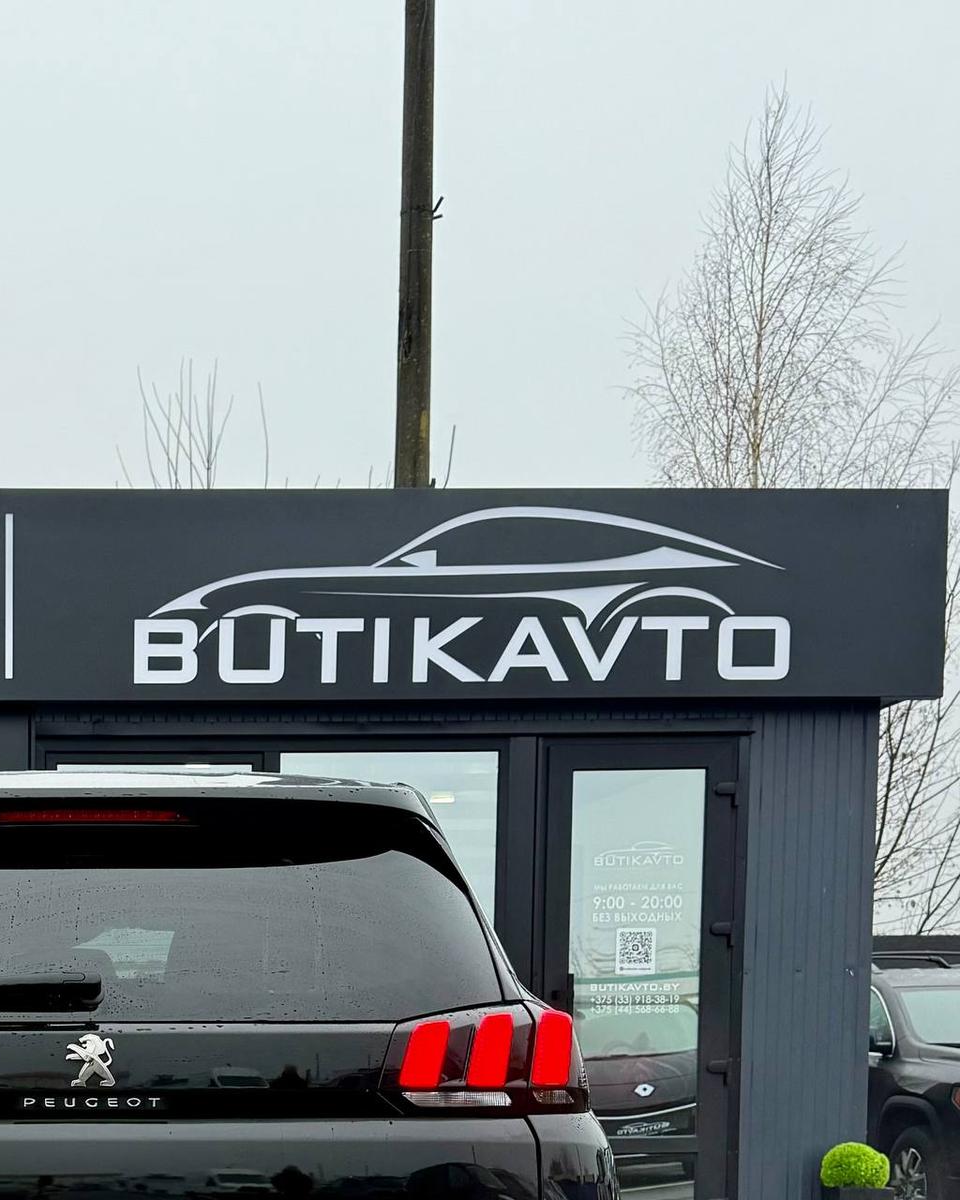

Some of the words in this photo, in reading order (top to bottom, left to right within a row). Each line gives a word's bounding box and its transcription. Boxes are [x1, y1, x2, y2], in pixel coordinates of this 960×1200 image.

[133, 616, 791, 685] BUTIKAVTO
[594, 855, 684, 866] BUTIKAVTO
[593, 896, 625, 909] 9:00
[641, 895, 682, 909] 20:00
[592, 912, 611, 922] БЕЗ
[614, 911, 682, 922] ВЫХОДНЫХ
[590, 983, 680, 992] BUTIKAVTO.BY
[590, 995, 613, 1004] +375
[614, 995, 632, 1006] (33)
[635, 995, 680, 1004] 918-38-19
[590, 1005, 612, 1014] +375
[614, 1005, 632, 1015] (44)
[22, 1096, 162, 1109] PEUGEOT
